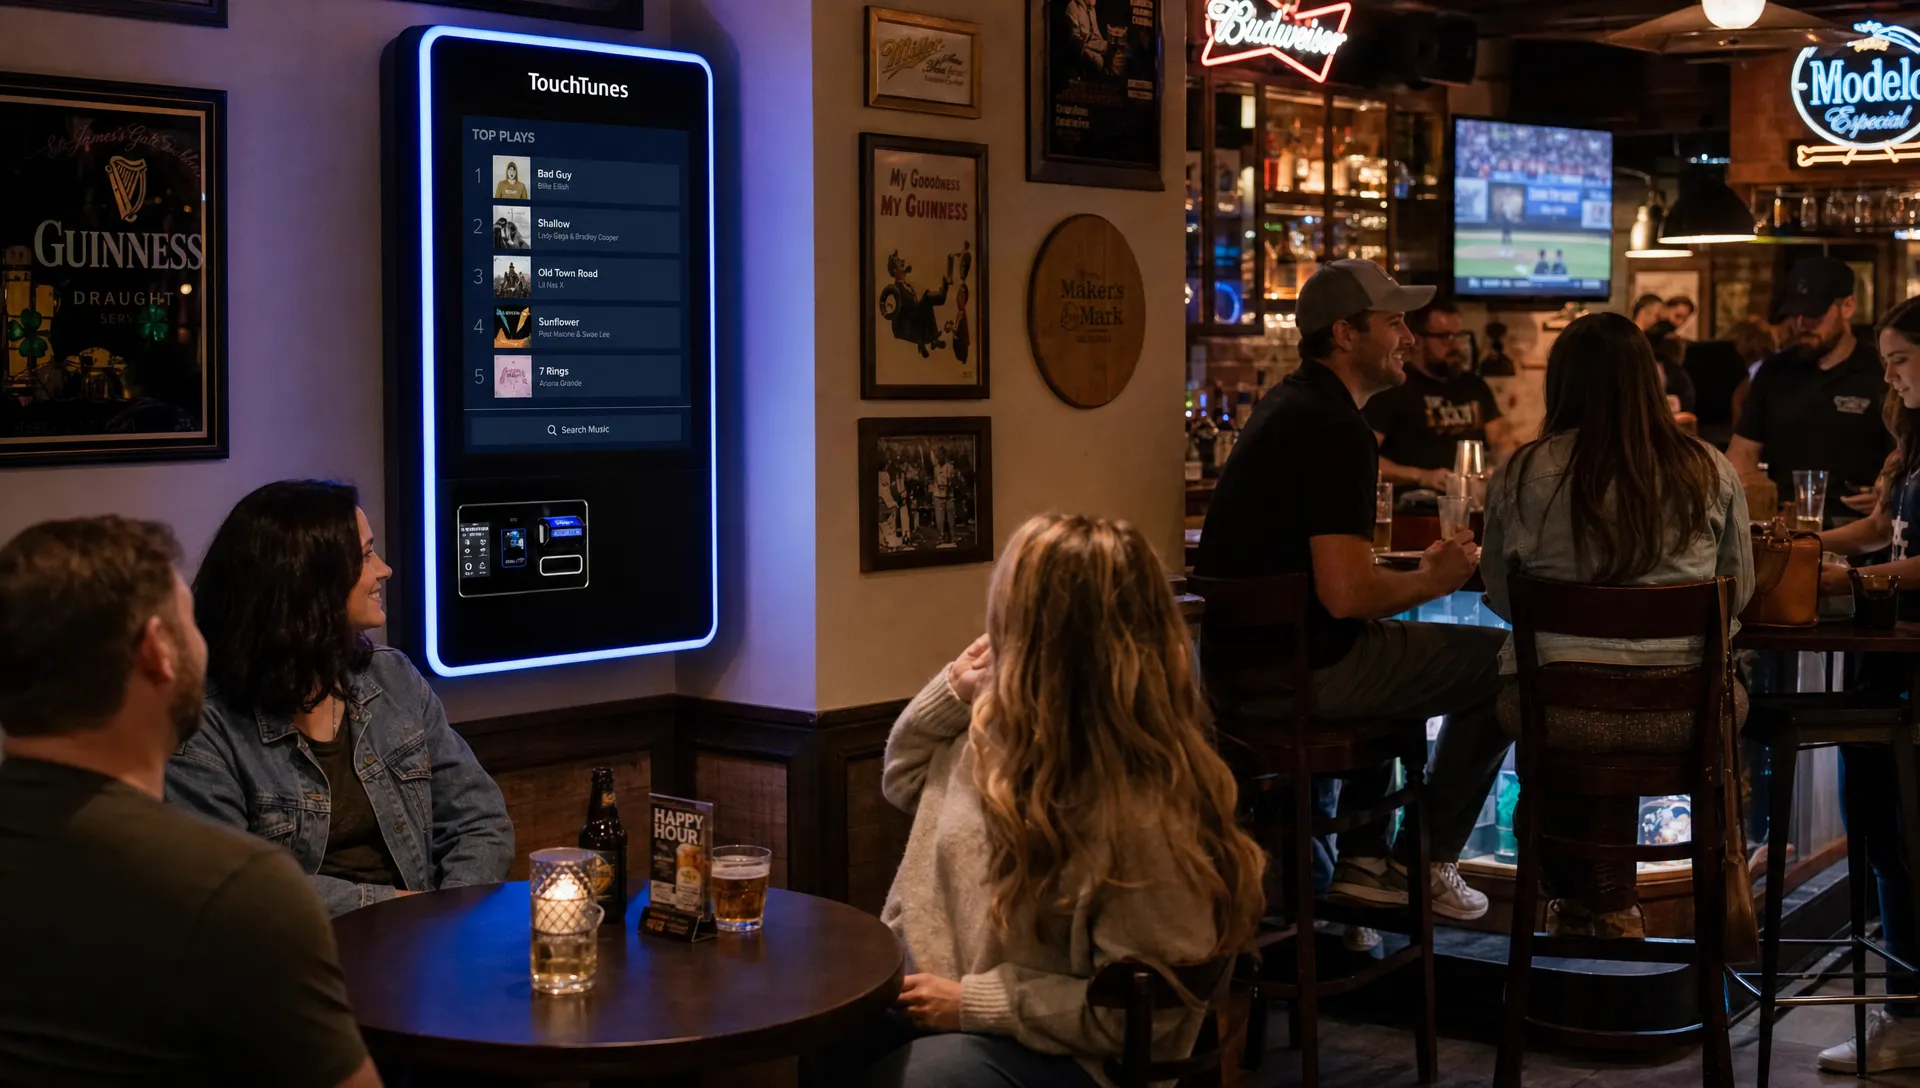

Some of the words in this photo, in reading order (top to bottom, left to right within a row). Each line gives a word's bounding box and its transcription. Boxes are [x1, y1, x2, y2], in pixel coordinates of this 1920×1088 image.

[1207, 0, 1348, 55] Budweiser
[881, 36, 946, 68] Miller
[528, 72, 629, 98] TouchTunes
[1825, 105, 1913, 139] Especial
[472, 128, 497, 141] TOP
[500, 130, 535, 143] PLAYS
[475, 168, 482, 183] 1
[537, 169, 554, 178] Bad
[555, 170, 573, 181] Guy
[905, 193, 969, 221] GUINNESS
[473, 219, 483, 234] 2
[537, 219, 570, 228] Shallow
[473, 269, 483, 284] 3
[538, 268, 553, 277] Old
[554, 268, 576, 277] Town
[578, 269, 598, 278] Road
[538, 281, 546, 289] Lil
[1060, 279, 1126, 301] Maker's
[74, 291, 173, 306] DRAUGHT
[538, 317, 580, 326] Sunflower
[1079, 306, 1124, 327] Mark
[473, 319, 484, 334] 4
[475, 369, 484, 384] 5
[539, 367, 544, 375] 7
[546, 367, 569, 377] Rings
[561, 426, 587, 434] Search
[588, 425, 610, 434] Music
[653, 808, 704, 832] HAPPY
